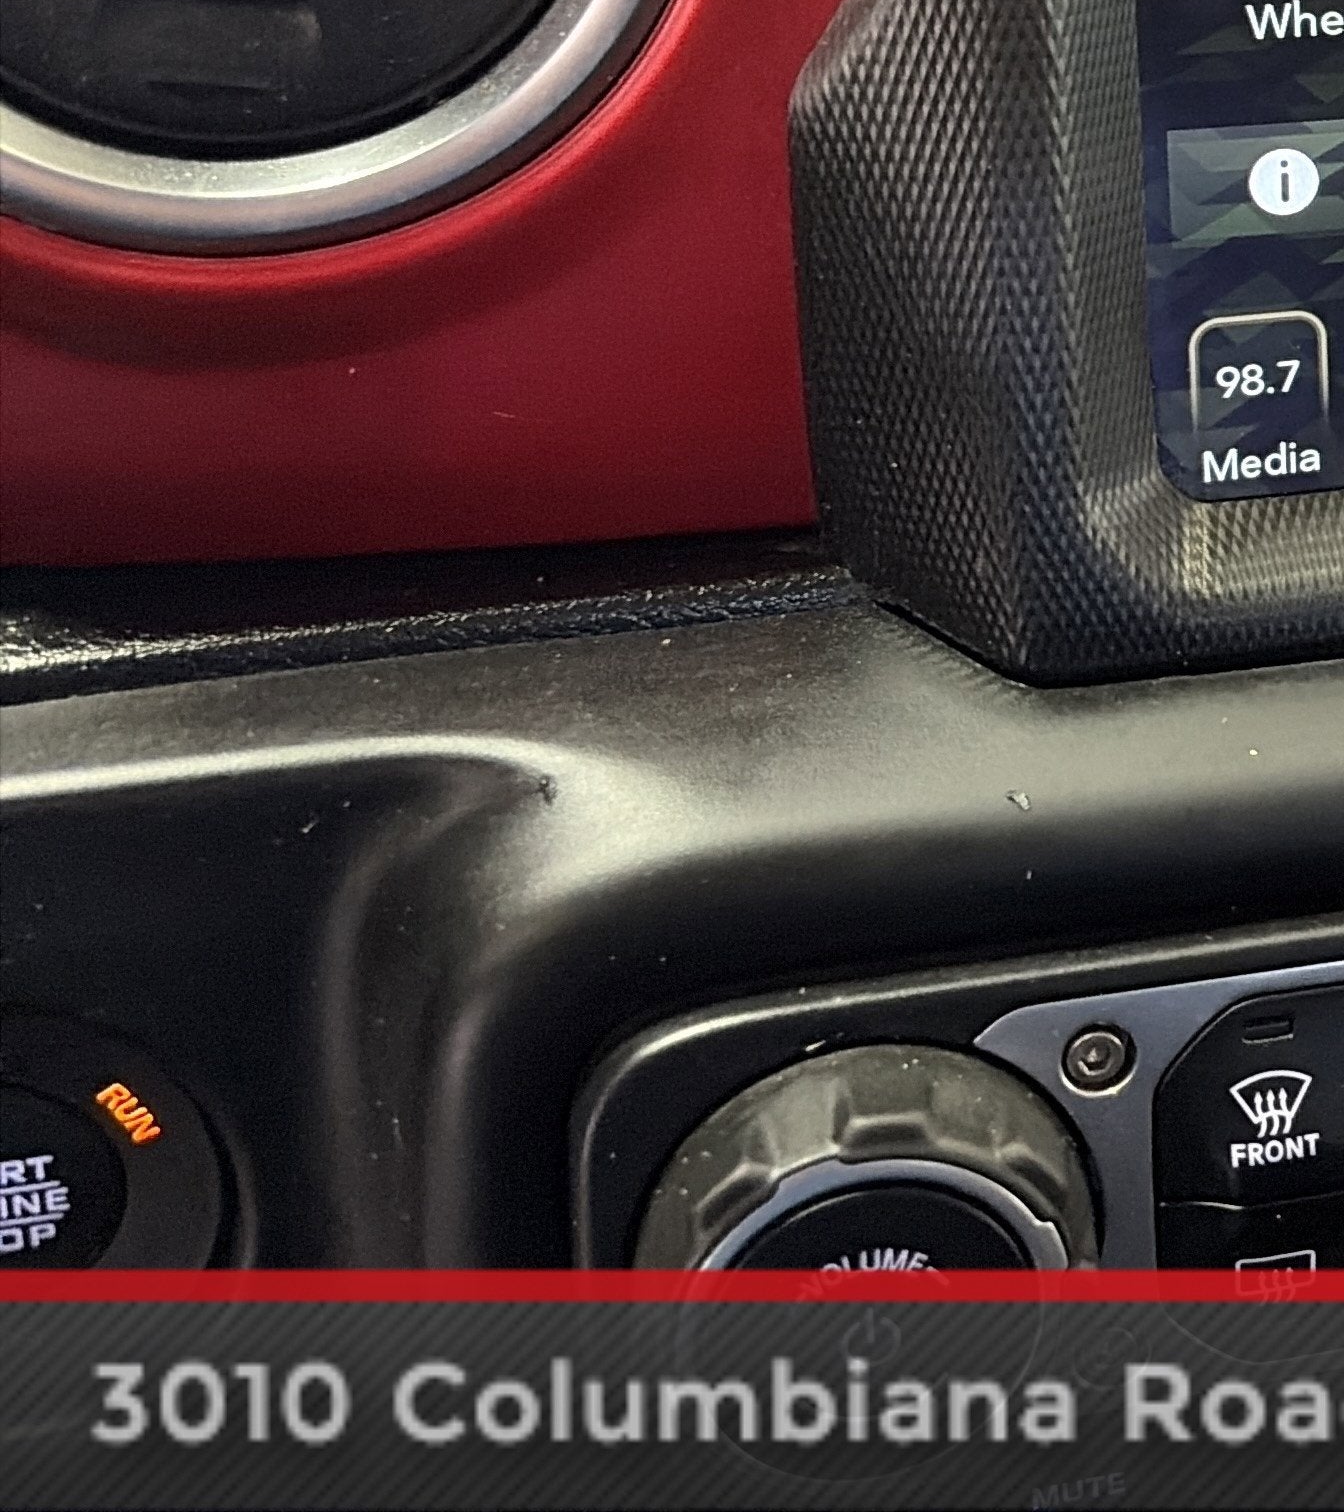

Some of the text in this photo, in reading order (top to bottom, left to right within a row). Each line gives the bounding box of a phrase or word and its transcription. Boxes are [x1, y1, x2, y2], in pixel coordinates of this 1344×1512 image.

[1215, 359, 1301, 399] 98.7
[1202, 441, 1321, 484] Media
[95, 1082, 161, 1143] RUN
[1230, 1131, 1321, 1168] FRONT
